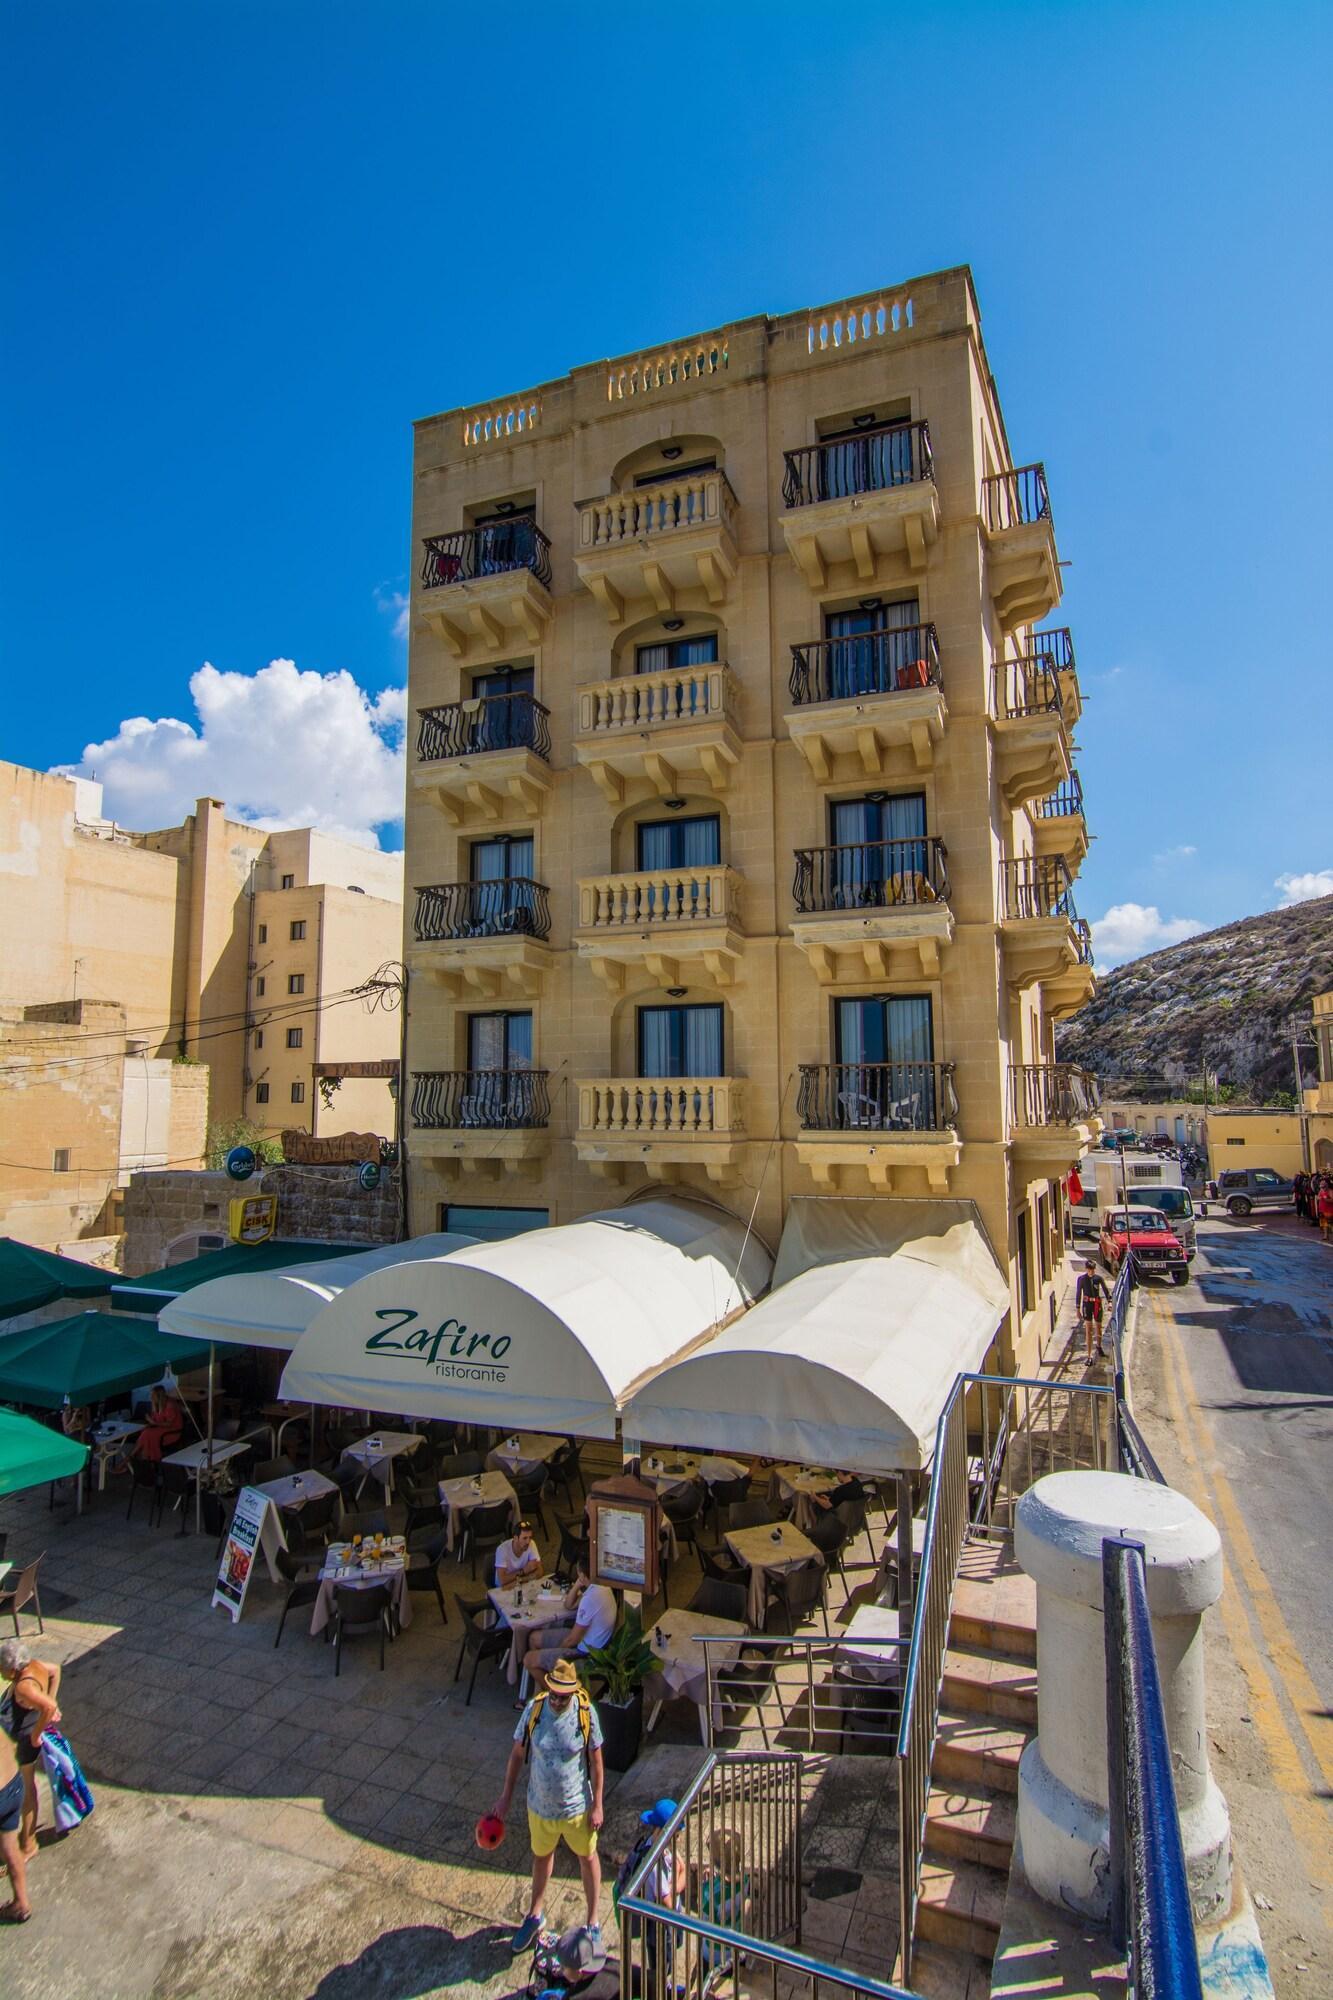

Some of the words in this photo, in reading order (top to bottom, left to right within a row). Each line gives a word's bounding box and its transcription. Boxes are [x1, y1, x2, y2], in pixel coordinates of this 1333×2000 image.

[245, 1215, 269, 1227] CISK
[366, 1309, 512, 1366] Zafiro
[435, 1363, 506, 1383] ristorante
[232, 1526, 254, 1545] Breakfast
[241, 1519, 258, 1535] English
